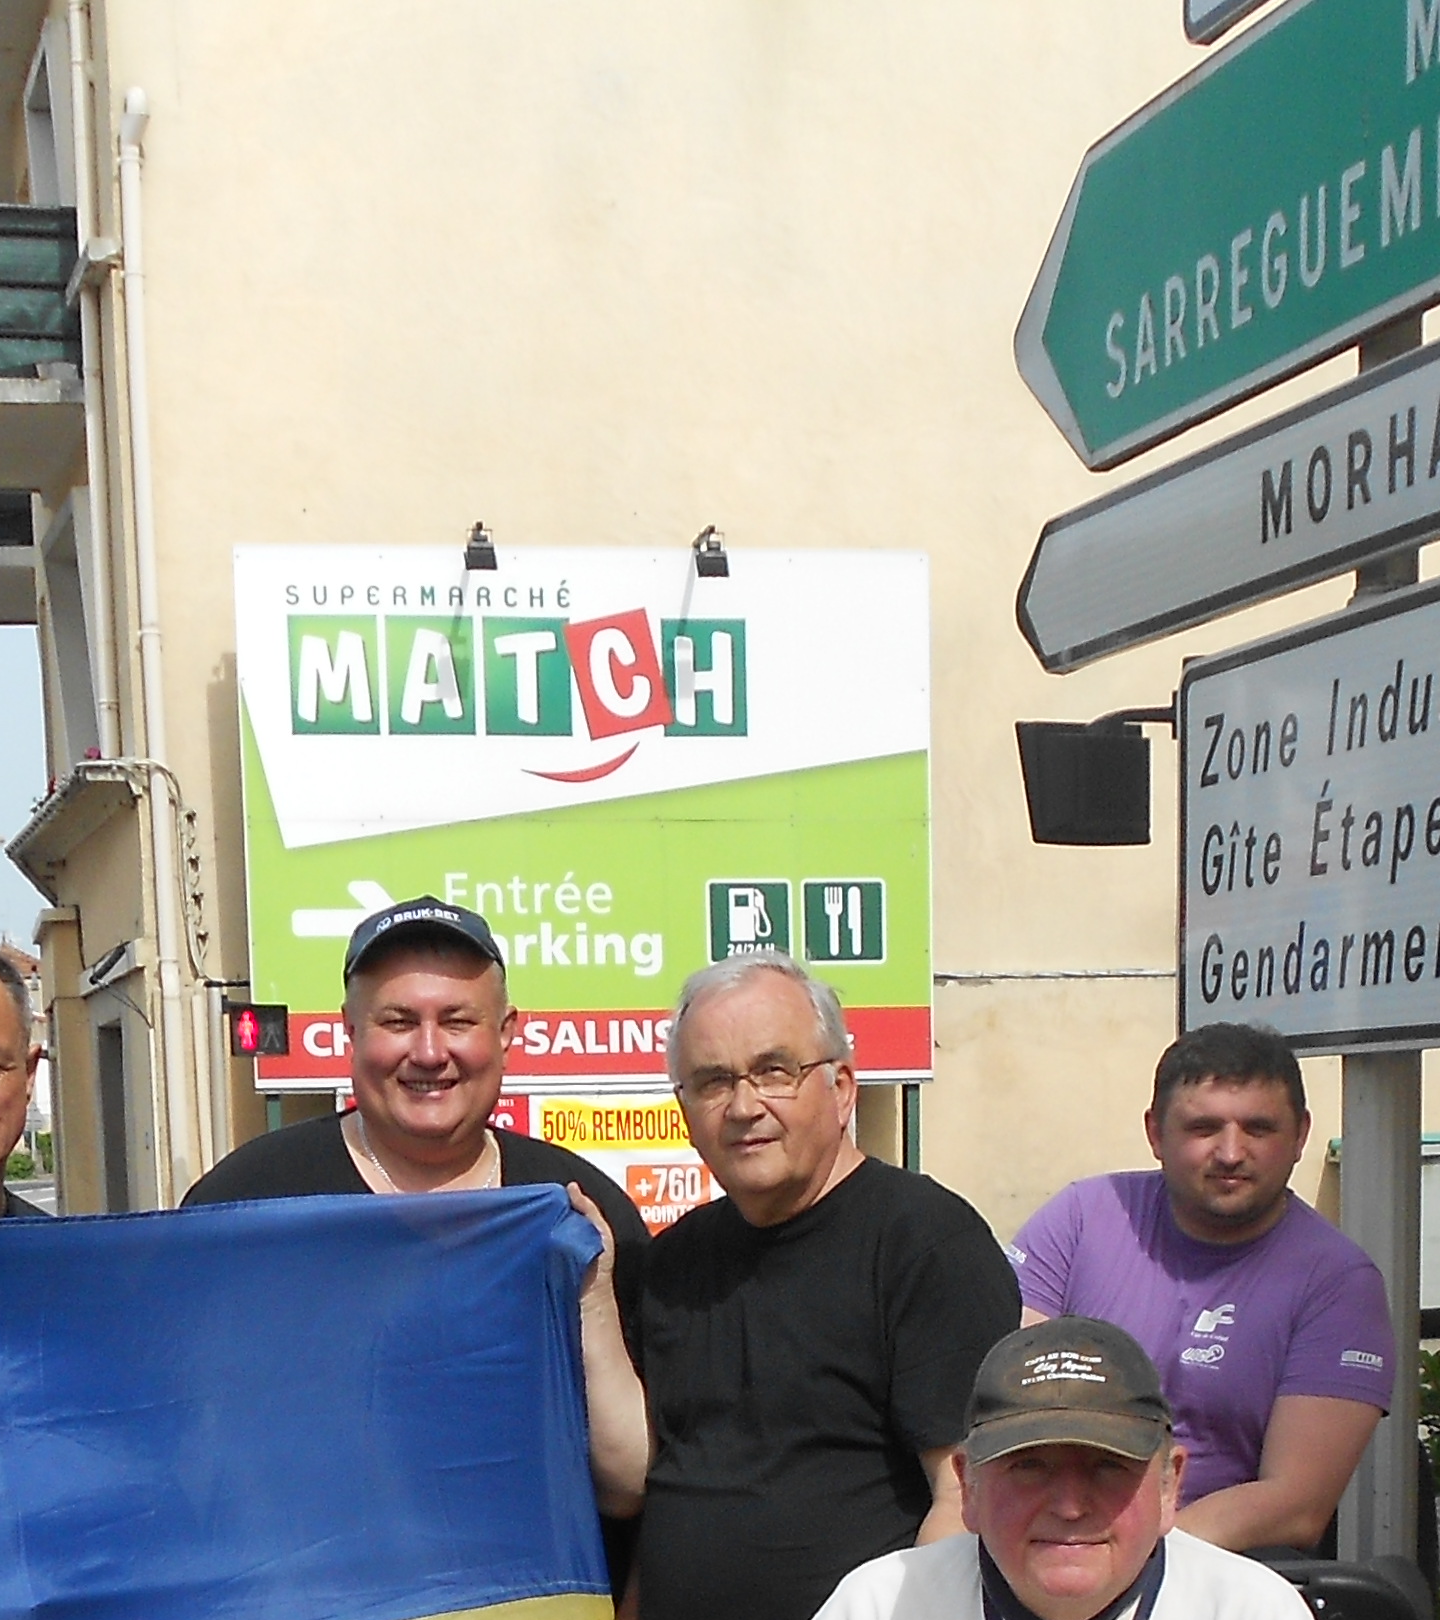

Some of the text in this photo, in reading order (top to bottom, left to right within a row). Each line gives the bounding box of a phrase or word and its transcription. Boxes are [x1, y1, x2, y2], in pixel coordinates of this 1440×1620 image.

[285, 580, 571, 608] SUPERMARCHÉ
[297, 626, 735, 728] MATCH
[1199, 712, 1299, 789] Zone
[1201, 821, 1282, 897] Gîte
[444, 871, 613, 914] Entrée
[492, 922, 664, 976] rking
[543, 1110, 587, 1142] 50%
[635, 1167, 702, 1202] +760
[640, 1204, 696, 1224] POINT
